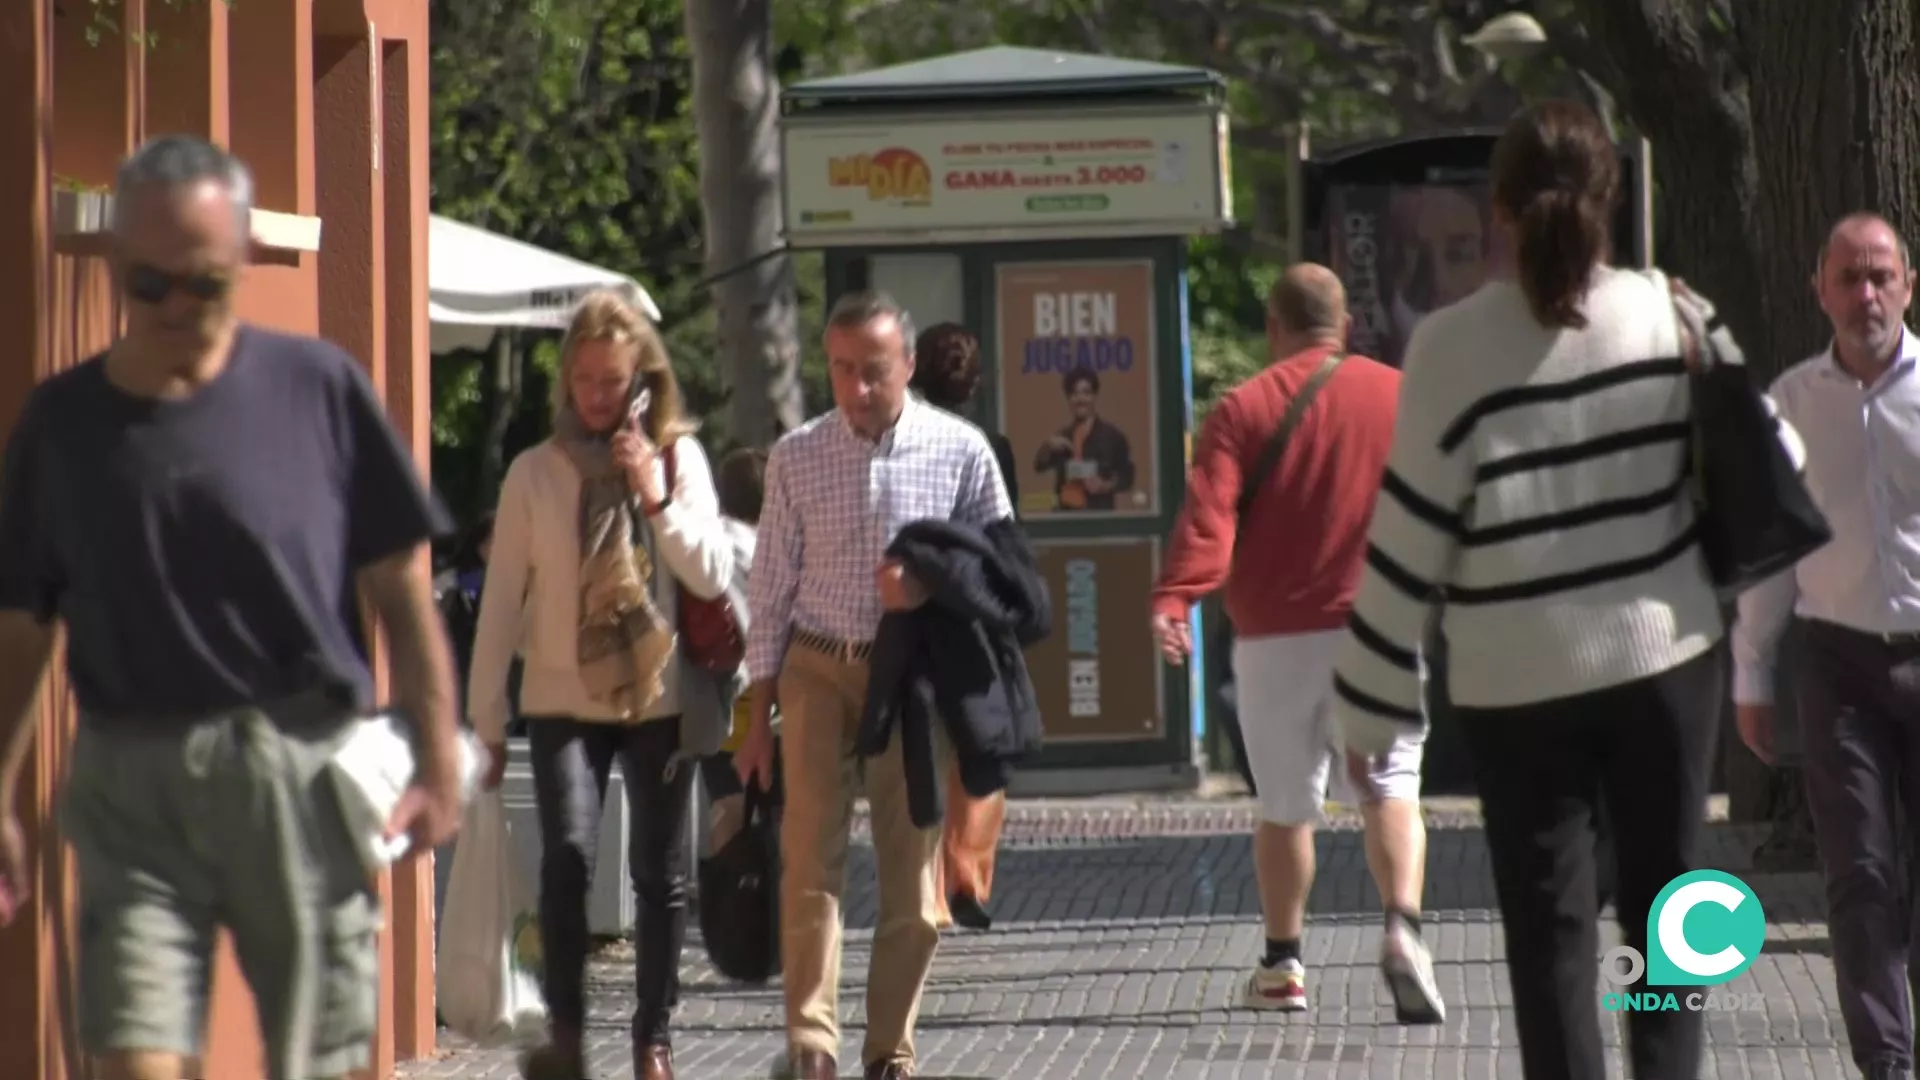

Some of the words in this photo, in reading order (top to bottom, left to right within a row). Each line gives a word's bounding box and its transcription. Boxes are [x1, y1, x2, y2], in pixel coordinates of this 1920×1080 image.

[944, 169, 1016, 191] GANA
[1033, 291, 1116, 337] BIEN
[1022, 336, 1133, 374] JUGADO
[1065, 559, 1098, 654] JUGADO
[1068, 658, 1101, 717] BIEN
